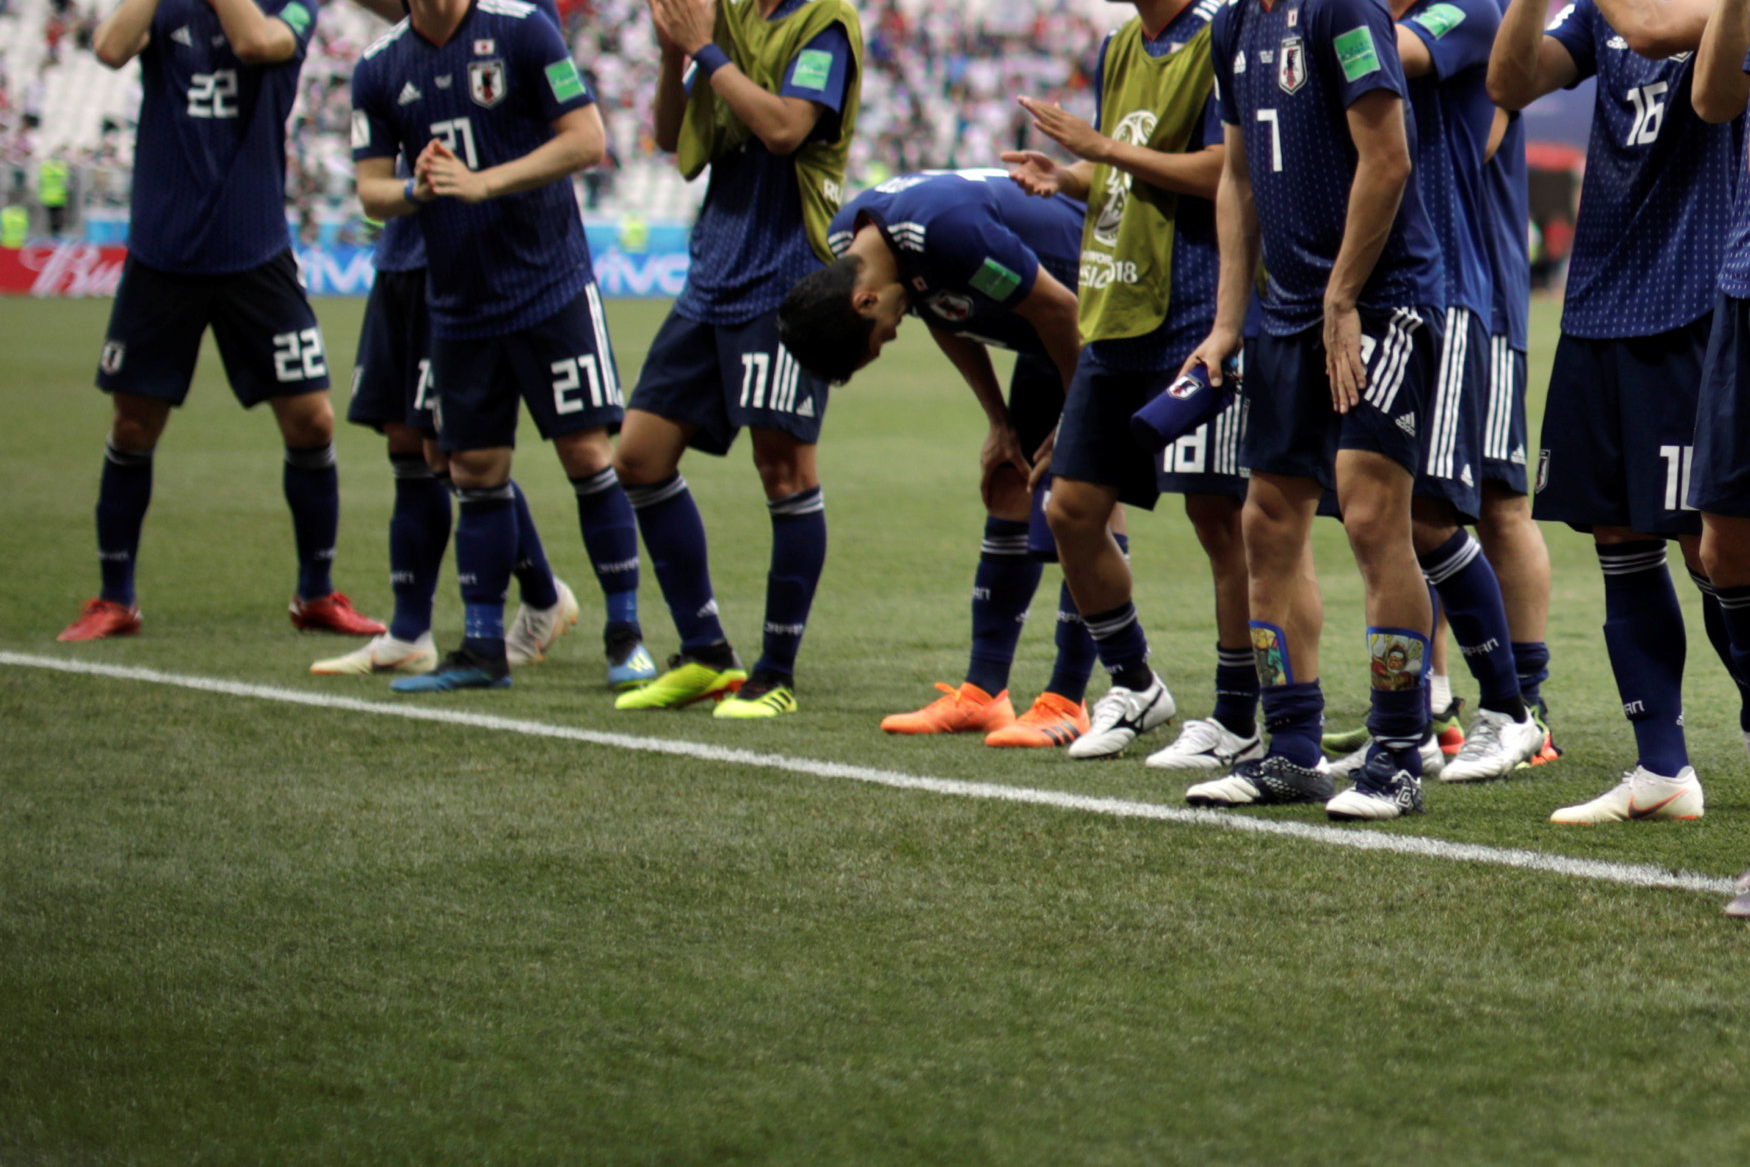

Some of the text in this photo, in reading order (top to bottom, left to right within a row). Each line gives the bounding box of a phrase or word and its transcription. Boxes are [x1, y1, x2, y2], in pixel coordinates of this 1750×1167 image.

[187, 69, 239, 118] 22
[1626, 81, 1668, 146] 16
[430, 117, 478, 170] 21
[1257, 109, 1282, 172] 7
[273, 327, 329, 381] 22
[740, 352, 769, 409] 11
[551, 353, 604, 415] 21
[1461, 637, 1499, 658] APAN
